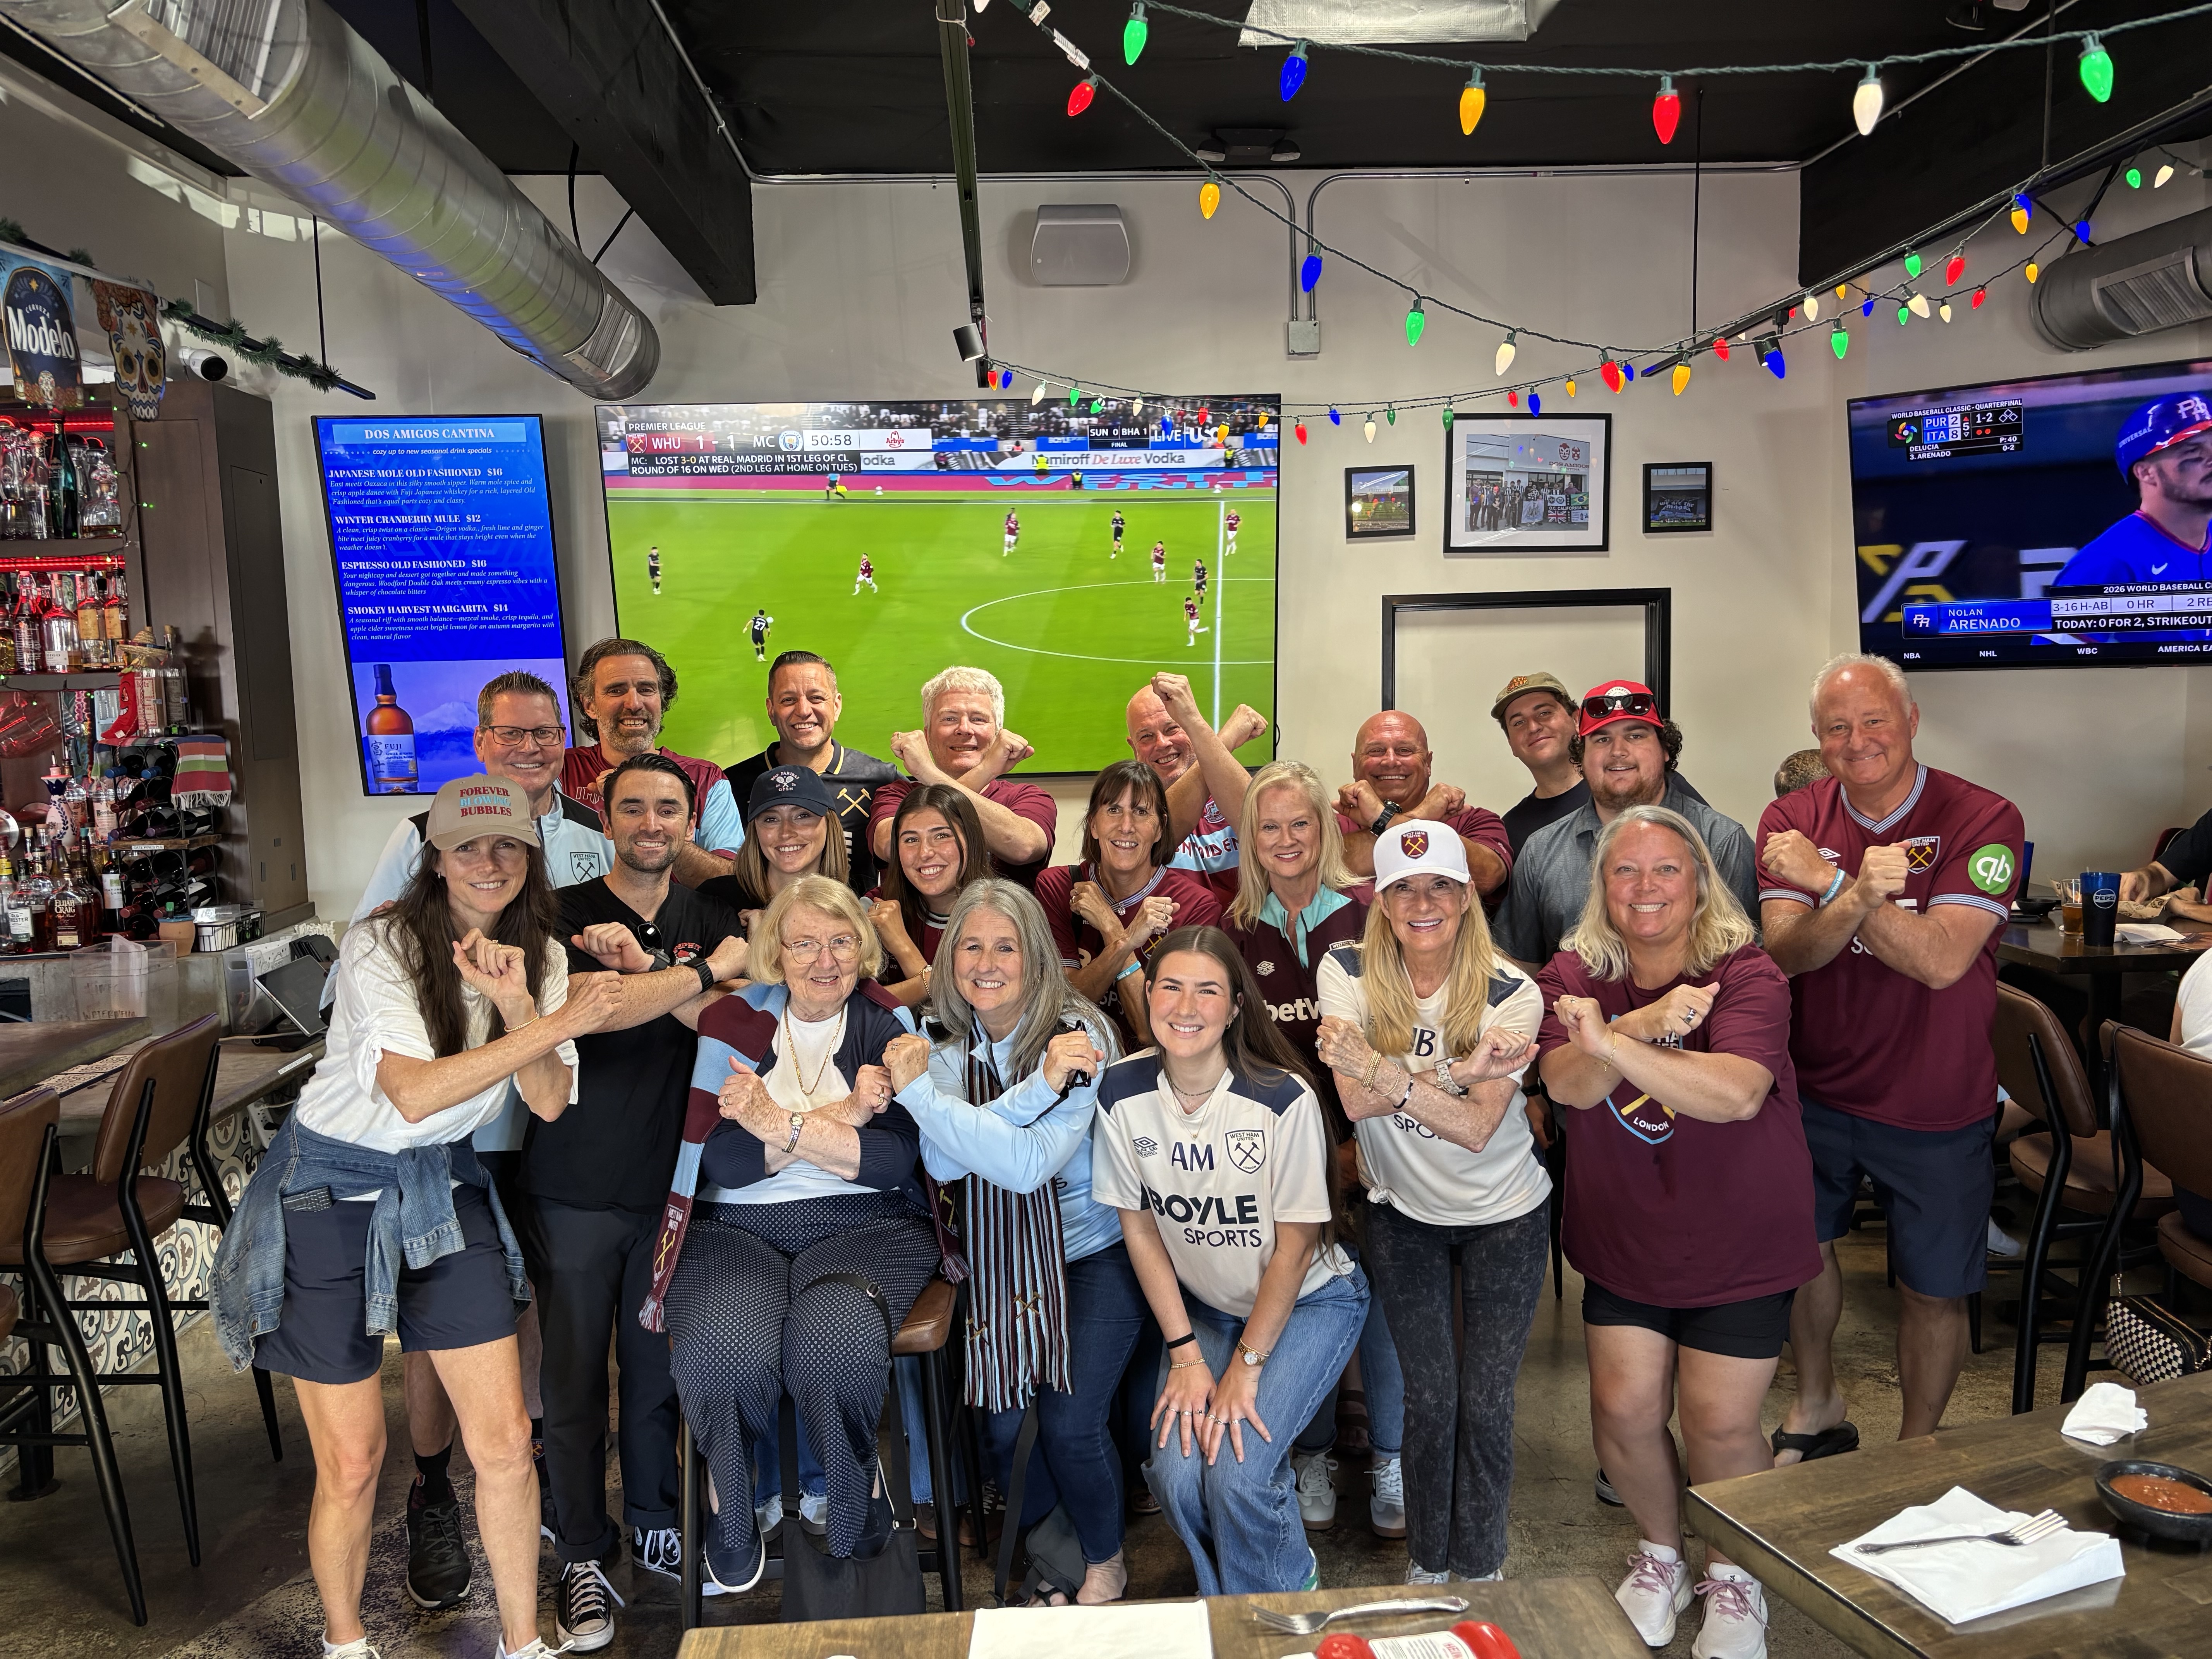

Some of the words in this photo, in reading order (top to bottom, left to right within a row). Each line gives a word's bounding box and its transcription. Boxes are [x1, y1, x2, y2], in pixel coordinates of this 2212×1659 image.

[25, 304, 51, 319] CERVEZA
[7, 306, 76, 360] Modelo
[1914, 408, 1945, 417] BASEBALL
[1946, 405, 1971, 414] CLASSIC
[1975, 400, 2023, 410] QUARTERFINAL
[1925, 417, 1947, 428] PUR
[1951, 416, 1958, 425] 2
[1976, 412, 1993, 423] 1-2
[670, 422, 706, 430] LEAGUE
[1963, 422, 1970, 431] 5
[364, 429, 390, 439] DOS
[393, 429, 440, 439] AMIGOS
[442, 428, 495, 438] CANTINA
[1927, 431, 1946, 441] ITA
[1951, 430, 1958, 439] 8
[652, 437, 681, 449] WHU
[696, 435, 703, 449] 1
[727, 434, 735, 449] 1
[753, 436, 775, 448] MC
[812, 434, 852, 446] 50:58
[1909, 444, 1939, 452] DELUCIA
[862, 454, 895, 465] odka
[1092, 454, 1108, 465] De
[1111, 454, 1142, 465] Luxe
[1144, 452, 1185, 464] Vodka
[1917, 451, 1951, 459] ARENADO
[329, 469, 375, 478] JAPANESE
[377, 469, 404, 477] MOLE
[405, 469, 426, 477] OLD
[427, 468, 481, 477] FASHIONED
[632, 466, 665, 474] ROUND
[731, 465, 753, 474] (2ND
[831, 463, 857, 472] TUES)
[335, 516, 374, 524] WINTER
[376, 515, 432, 524] CRANBERRY
[466, 514, 481, 522] $12
[341, 561, 390, 570] ESPRESSO
[412, 560, 466, 569] FASHIONED
[2160, 583, 2203, 591] BASEBALL
[348, 606, 386, 615] SMOKEY
[388, 606, 431, 614] HARVEST
[433, 605, 488, 613] MARGARITA
[2053, 603, 2078, 611] 3-16
[2080, 601, 2108, 611] H-AB
[2127, 600, 2134, 609] 0
[2137, 599, 2154, 609] HR
[2187, 598, 2194, 607] 2
[1948, 608, 1983, 617] NOLAN
[755, 620, 766, 631] 27
[1949, 618, 2020, 630] ARENADO
[2055, 619, 2097, 629] TODAY:
[2099, 618, 2106, 627] 0
[2109, 618, 2131, 627] FOR
[2133, 617, 2145, 628] 2,
[2147, 616, 2212, 626] STRIKEOUT
[371, 740, 385, 773] 富士
[460, 786, 510, 797] FOREVER
[460, 795, 511, 807] BLOWING
[460, 806, 512, 817] BUBBLES
[55, 906, 76, 914] CRAIG
[1394, 1114, 1442, 1140] SPO
[1633, 1116, 1669, 1132] LONDON
[1171, 1142, 1214, 1172] AM
[1147, 1186, 1259, 1225] BOYLE
[1184, 1228, 1262, 1248] SPORTS
